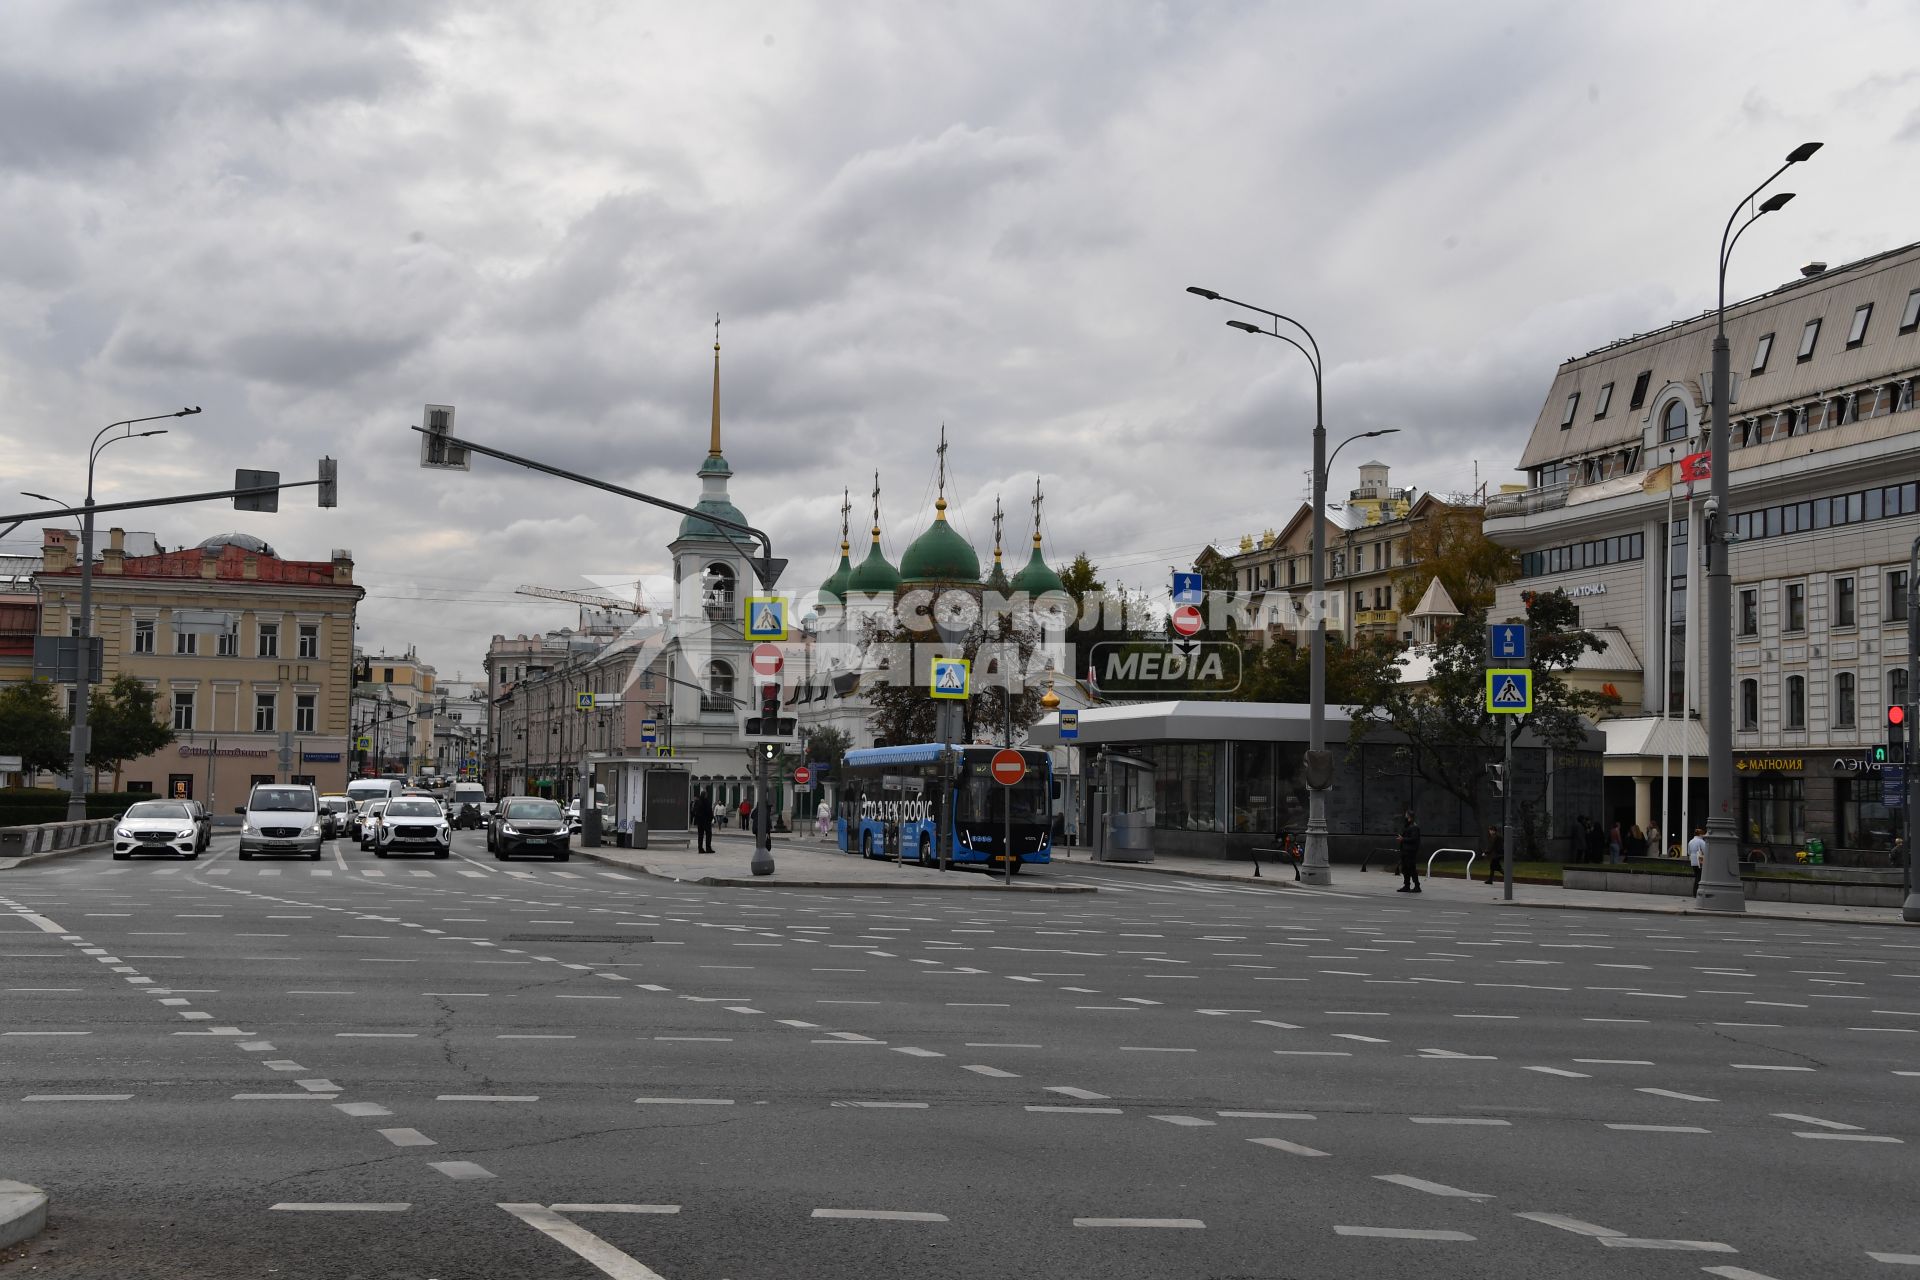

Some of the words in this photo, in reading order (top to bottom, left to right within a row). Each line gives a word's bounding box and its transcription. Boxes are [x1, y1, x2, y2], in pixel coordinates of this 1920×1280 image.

[1580, 583, 1607, 596] ТОЧКА
[1749, 759, 1803, 770] МАГНОЛИЯ
[860, 793, 876, 819] Это
